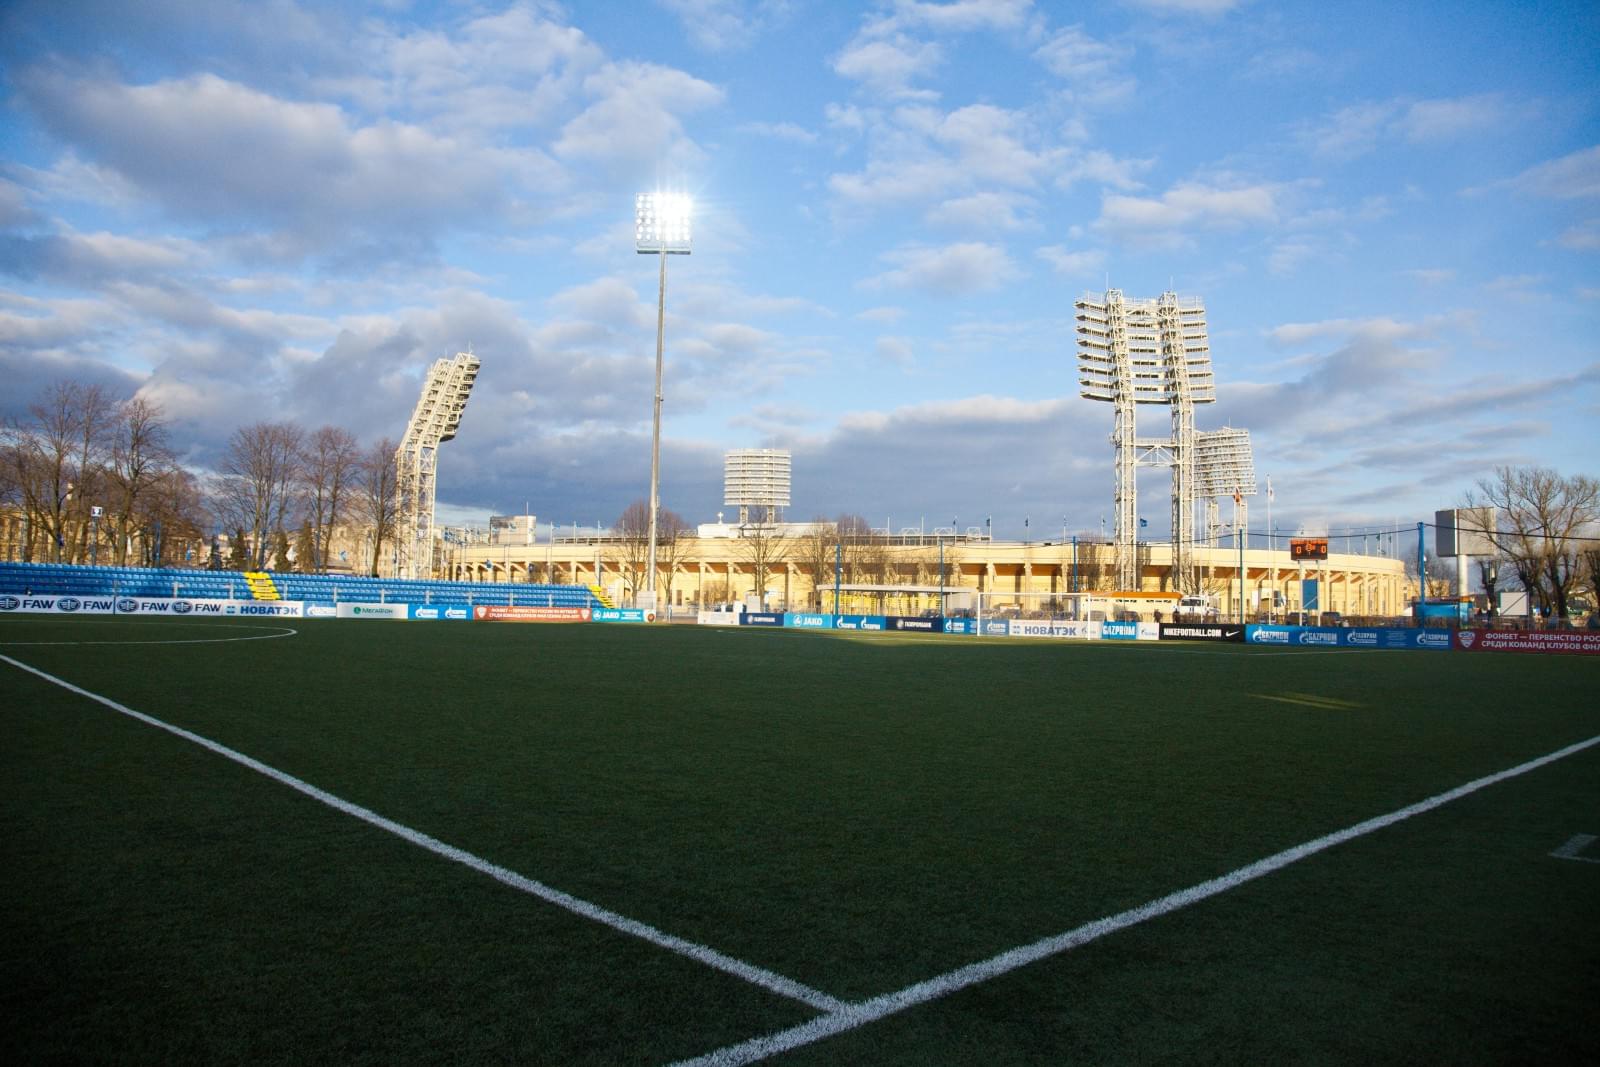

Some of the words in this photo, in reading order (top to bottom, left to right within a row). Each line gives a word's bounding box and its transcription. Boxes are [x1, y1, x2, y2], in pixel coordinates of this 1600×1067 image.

[23, 600, 54, 608] FAW
[83, 601, 112, 609] FAW
[141, 602, 169, 610] FAW
[240, 606, 298, 615] НОВАТЭК
[1024, 626, 1077, 635] НОВАТЭК
[1102, 625, 1136, 635] GAZPROM
[1163, 628, 1222, 637] NIKEFOOTBALL.COM
[1261, 631, 1289, 639] GAZPROM
[1308, 632, 1337, 641] GAZPROM
[1529, 633, 1581, 641] ПЕРВЕНСТВО
[1481, 640, 1507, 648] СРЕДИ
[1508, 641, 1545, 649] КОМАНД
[1547, 641, 1580, 649] КЛУБОВ
